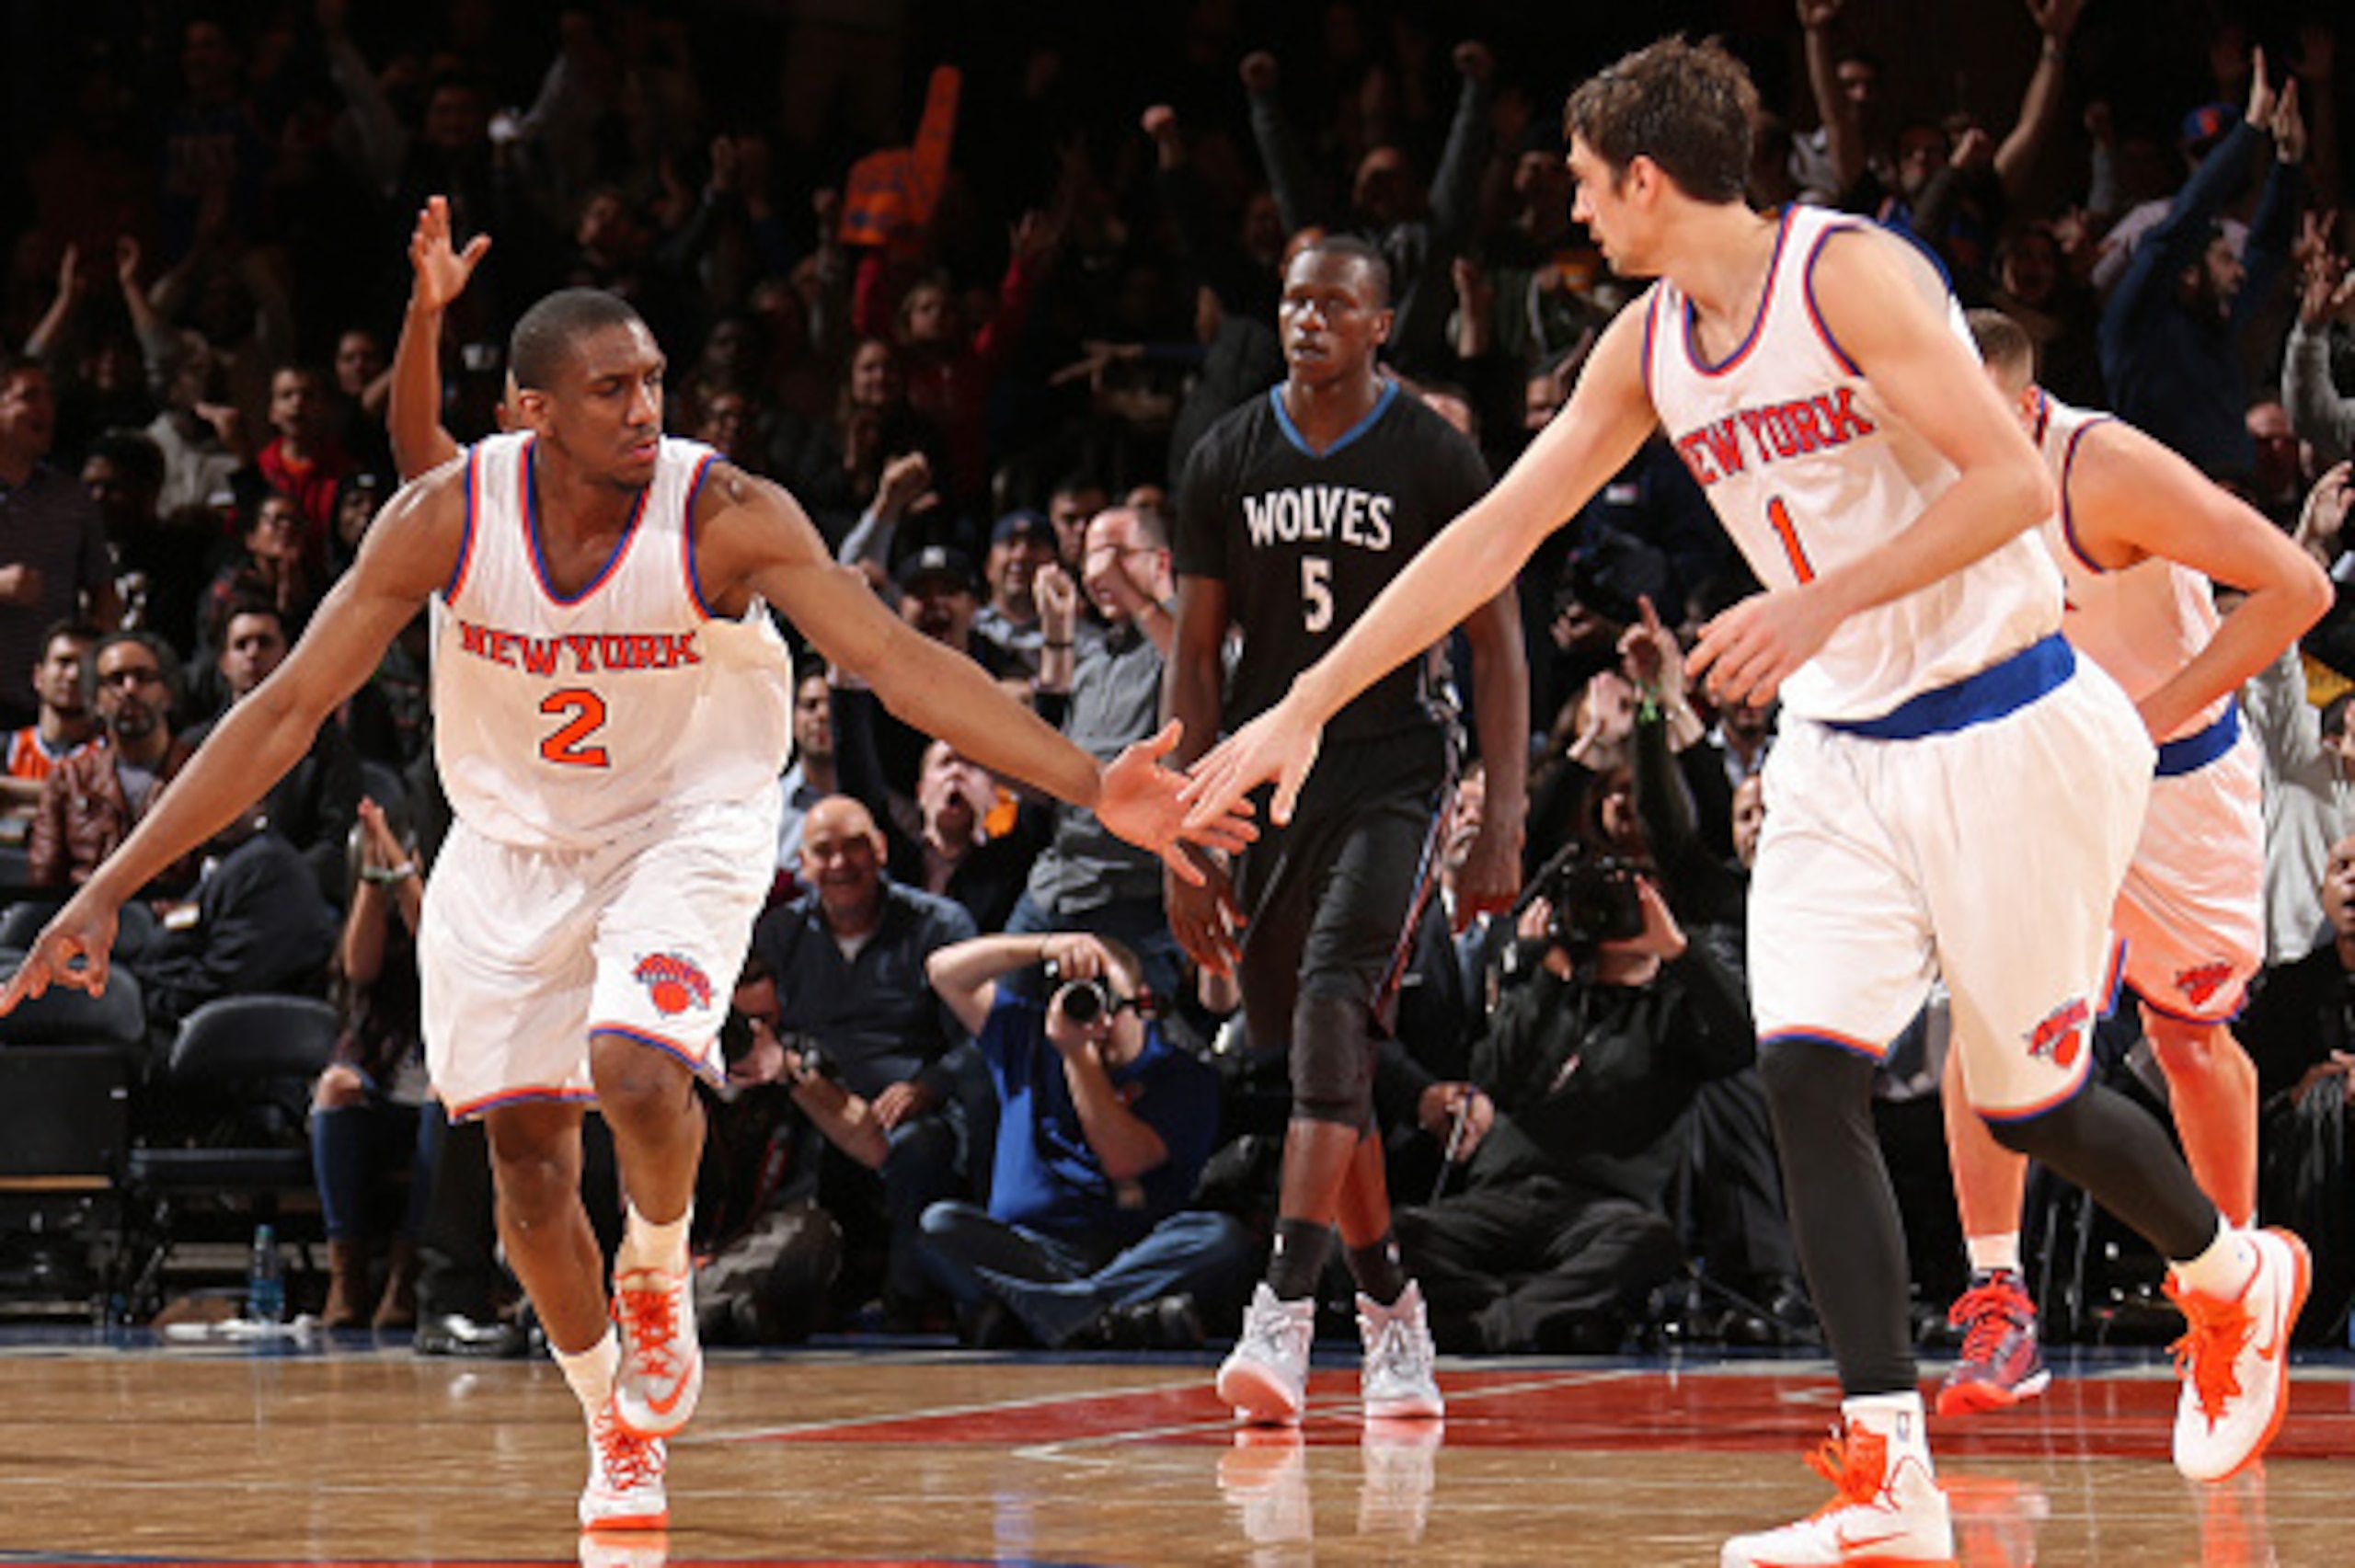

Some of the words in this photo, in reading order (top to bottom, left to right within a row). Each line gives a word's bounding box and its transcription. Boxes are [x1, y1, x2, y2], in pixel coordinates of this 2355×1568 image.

[1675, 414, 1744, 487] EW
[1738, 386, 1877, 464] YORK
[1243, 483, 1395, 552] WOLVES
[1766, 494, 1816, 585] 1
[1299, 555, 1335, 634] 5
[460, 620, 562, 677] NEW
[562, 630, 702, 674] YORK
[539, 687, 610, 768] 2
